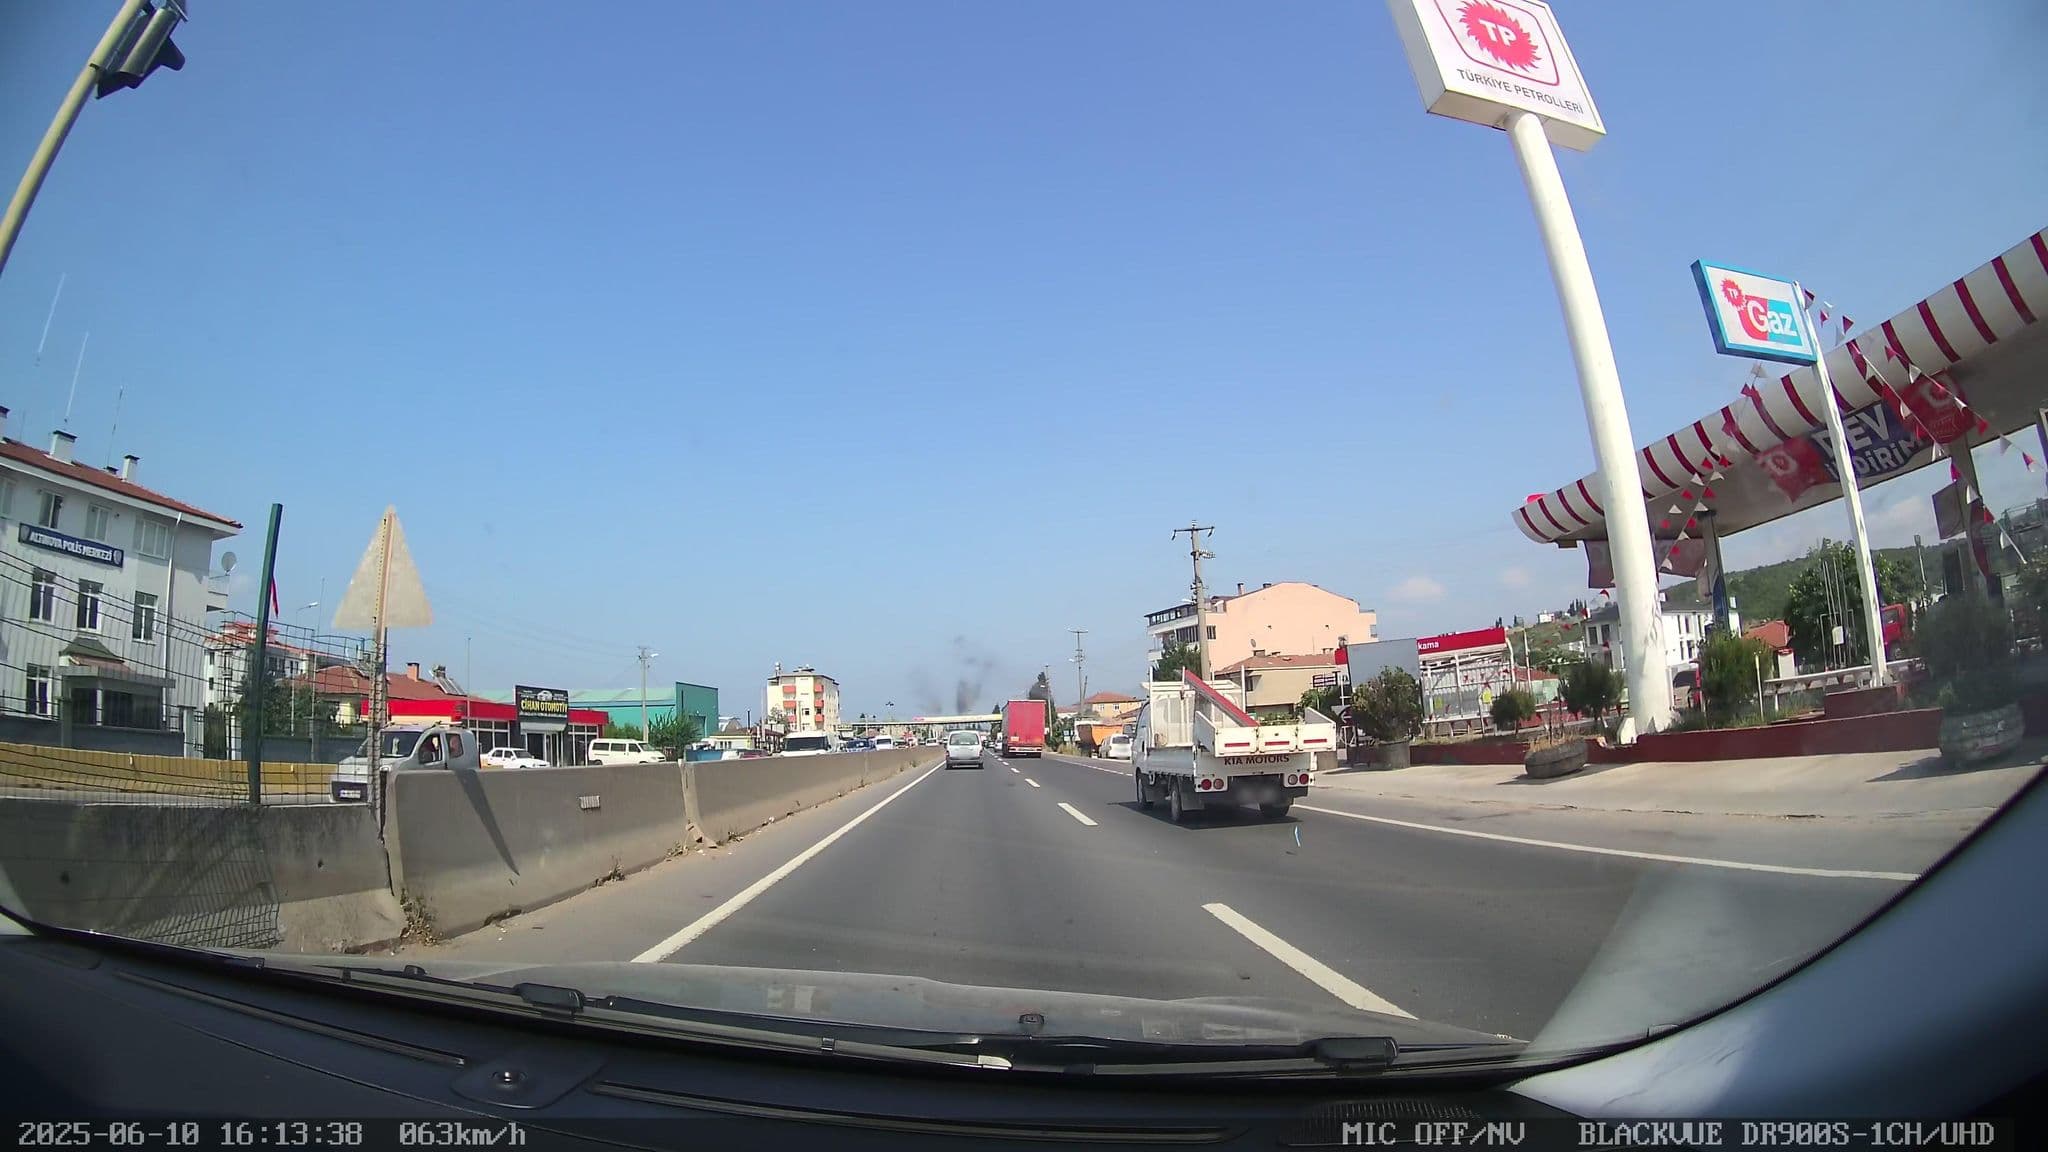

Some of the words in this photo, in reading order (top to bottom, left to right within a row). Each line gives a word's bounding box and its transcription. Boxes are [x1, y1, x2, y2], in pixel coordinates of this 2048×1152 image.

[1477, 18, 1518, 47] TP
[1456, 68, 1513, 93] TÜRKİYE
[1514, 84, 1584, 115] PETROLLERİ
[1746, 299, 1799, 337] Gaz
[62, 540, 84, 555] POLİS
[1224, 756, 1243, 766] KIA
[1246, 754, 1290, 765] MOTORS
